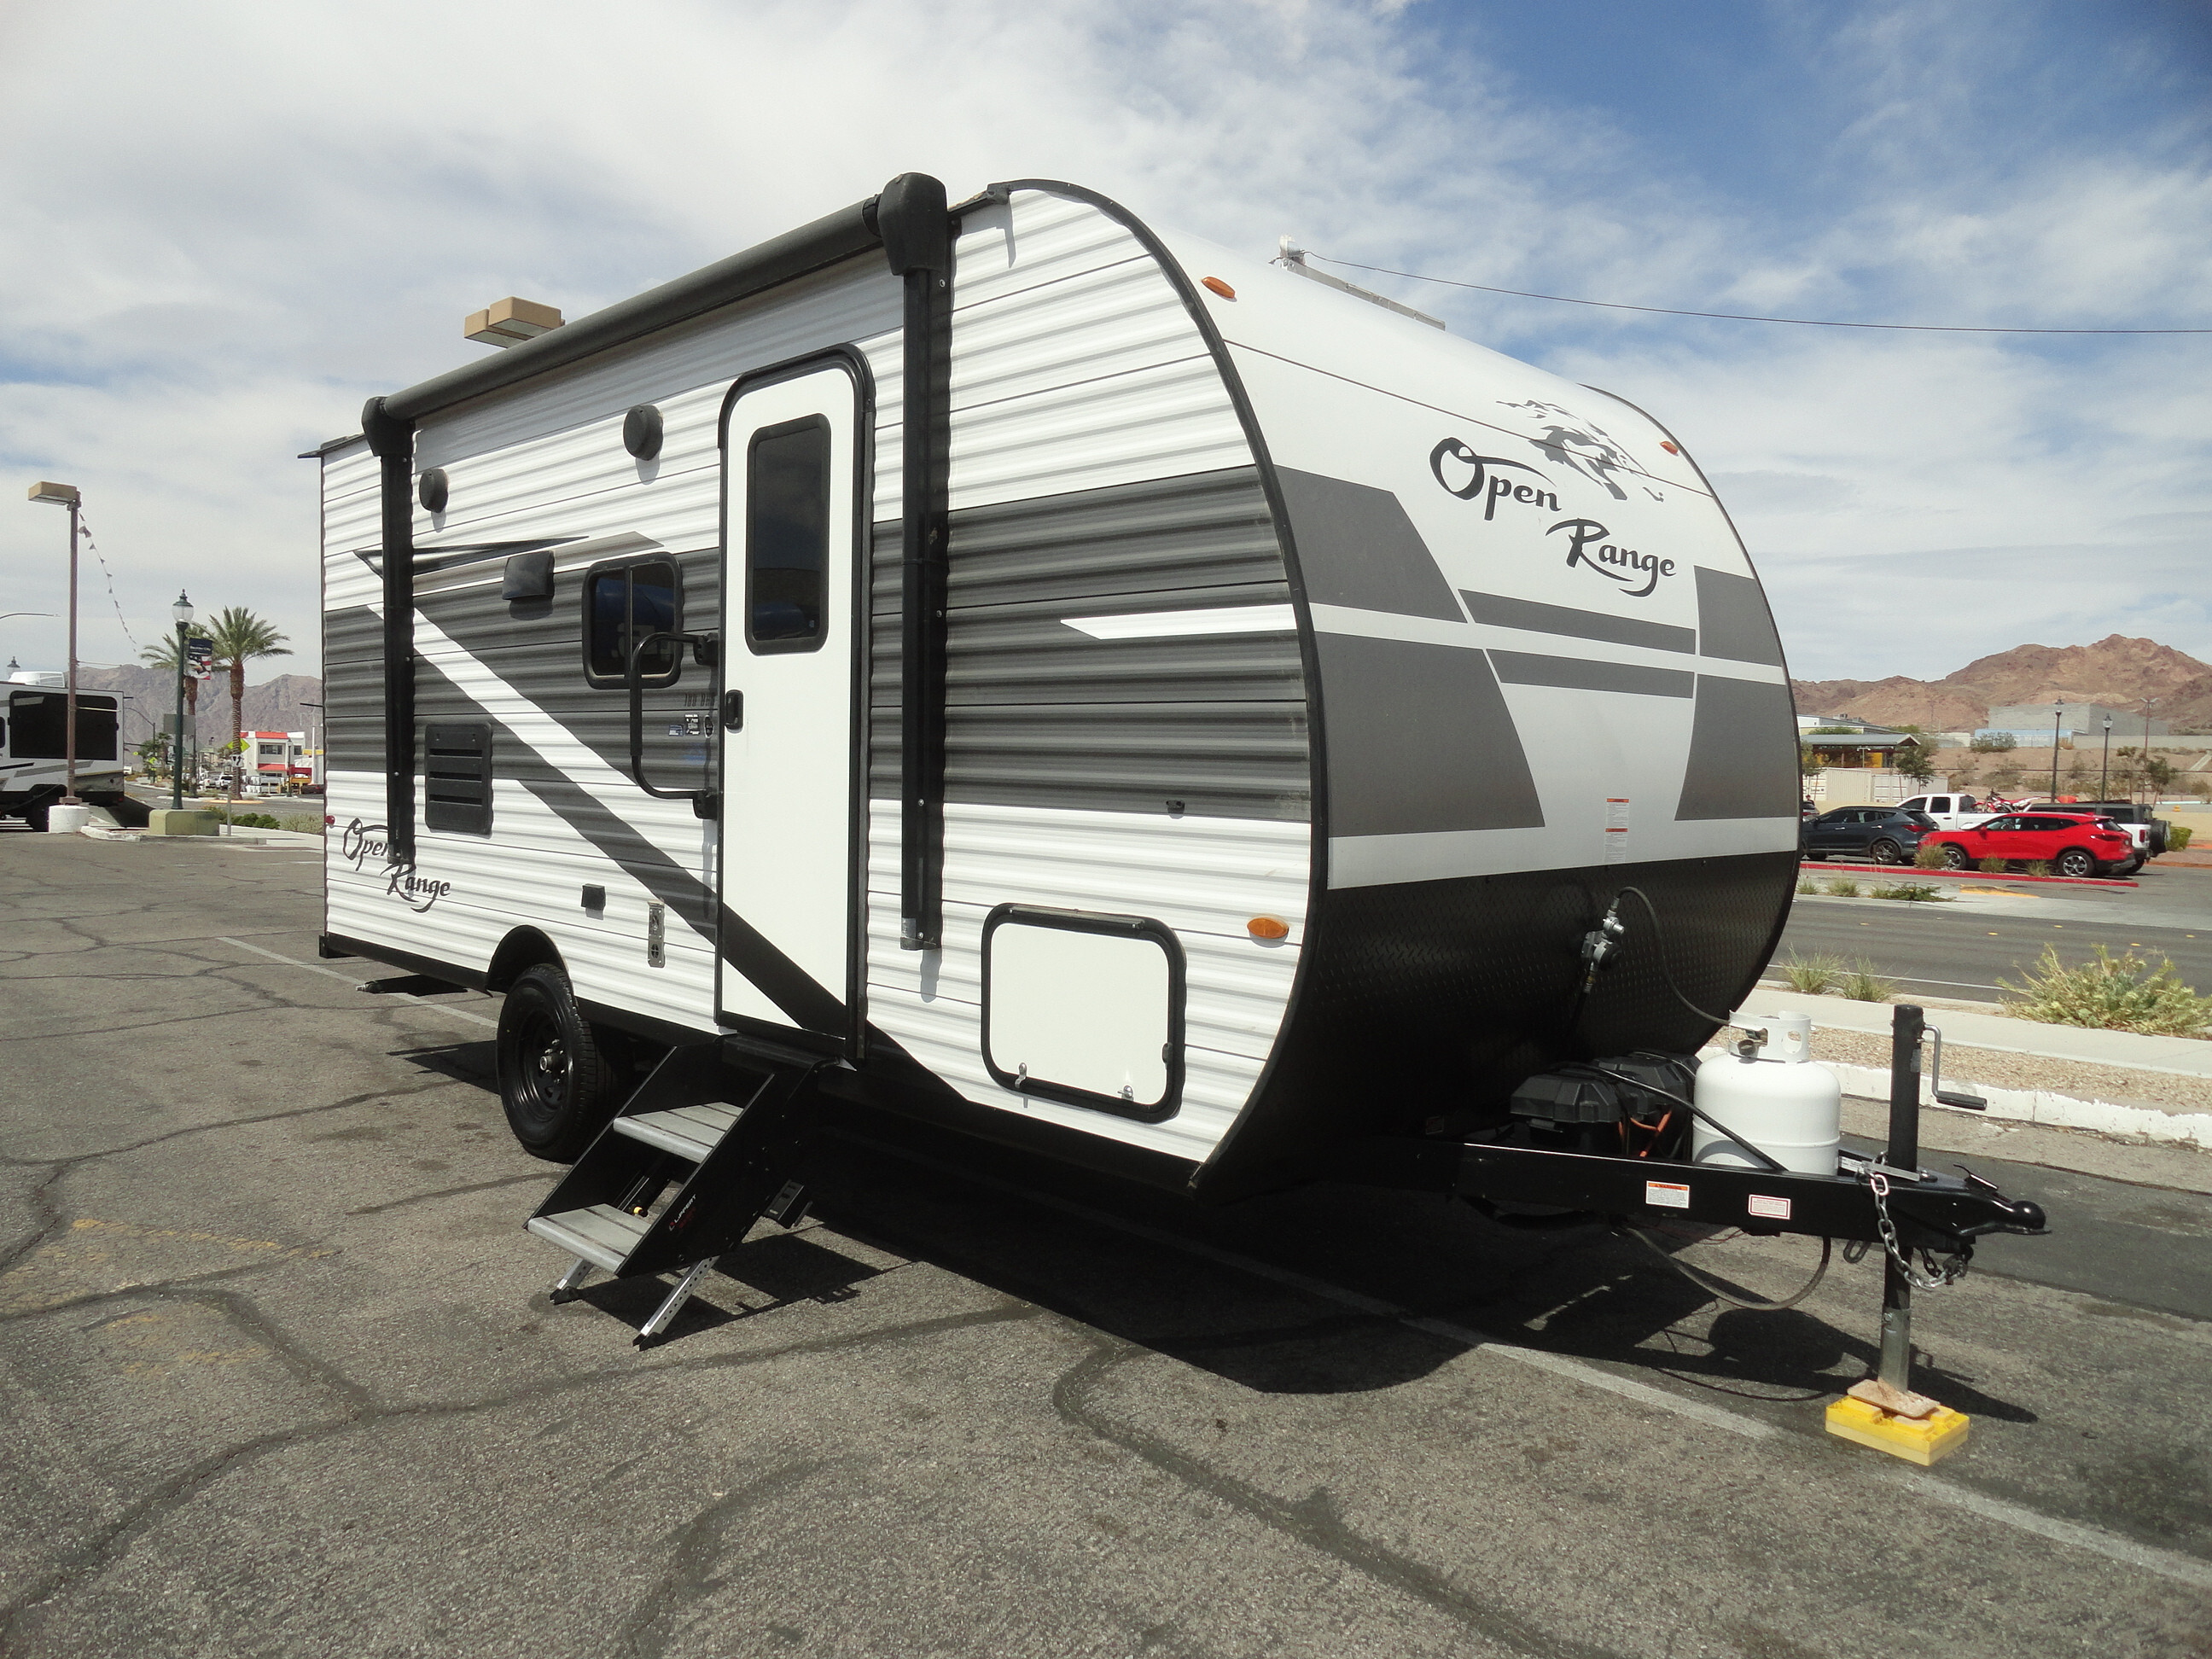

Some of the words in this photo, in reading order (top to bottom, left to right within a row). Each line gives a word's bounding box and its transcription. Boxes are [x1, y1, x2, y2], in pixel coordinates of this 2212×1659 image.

[1429, 437, 1562, 521] Open
[1545, 517, 1677, 597] Range
[379, 863, 451, 913] Range
